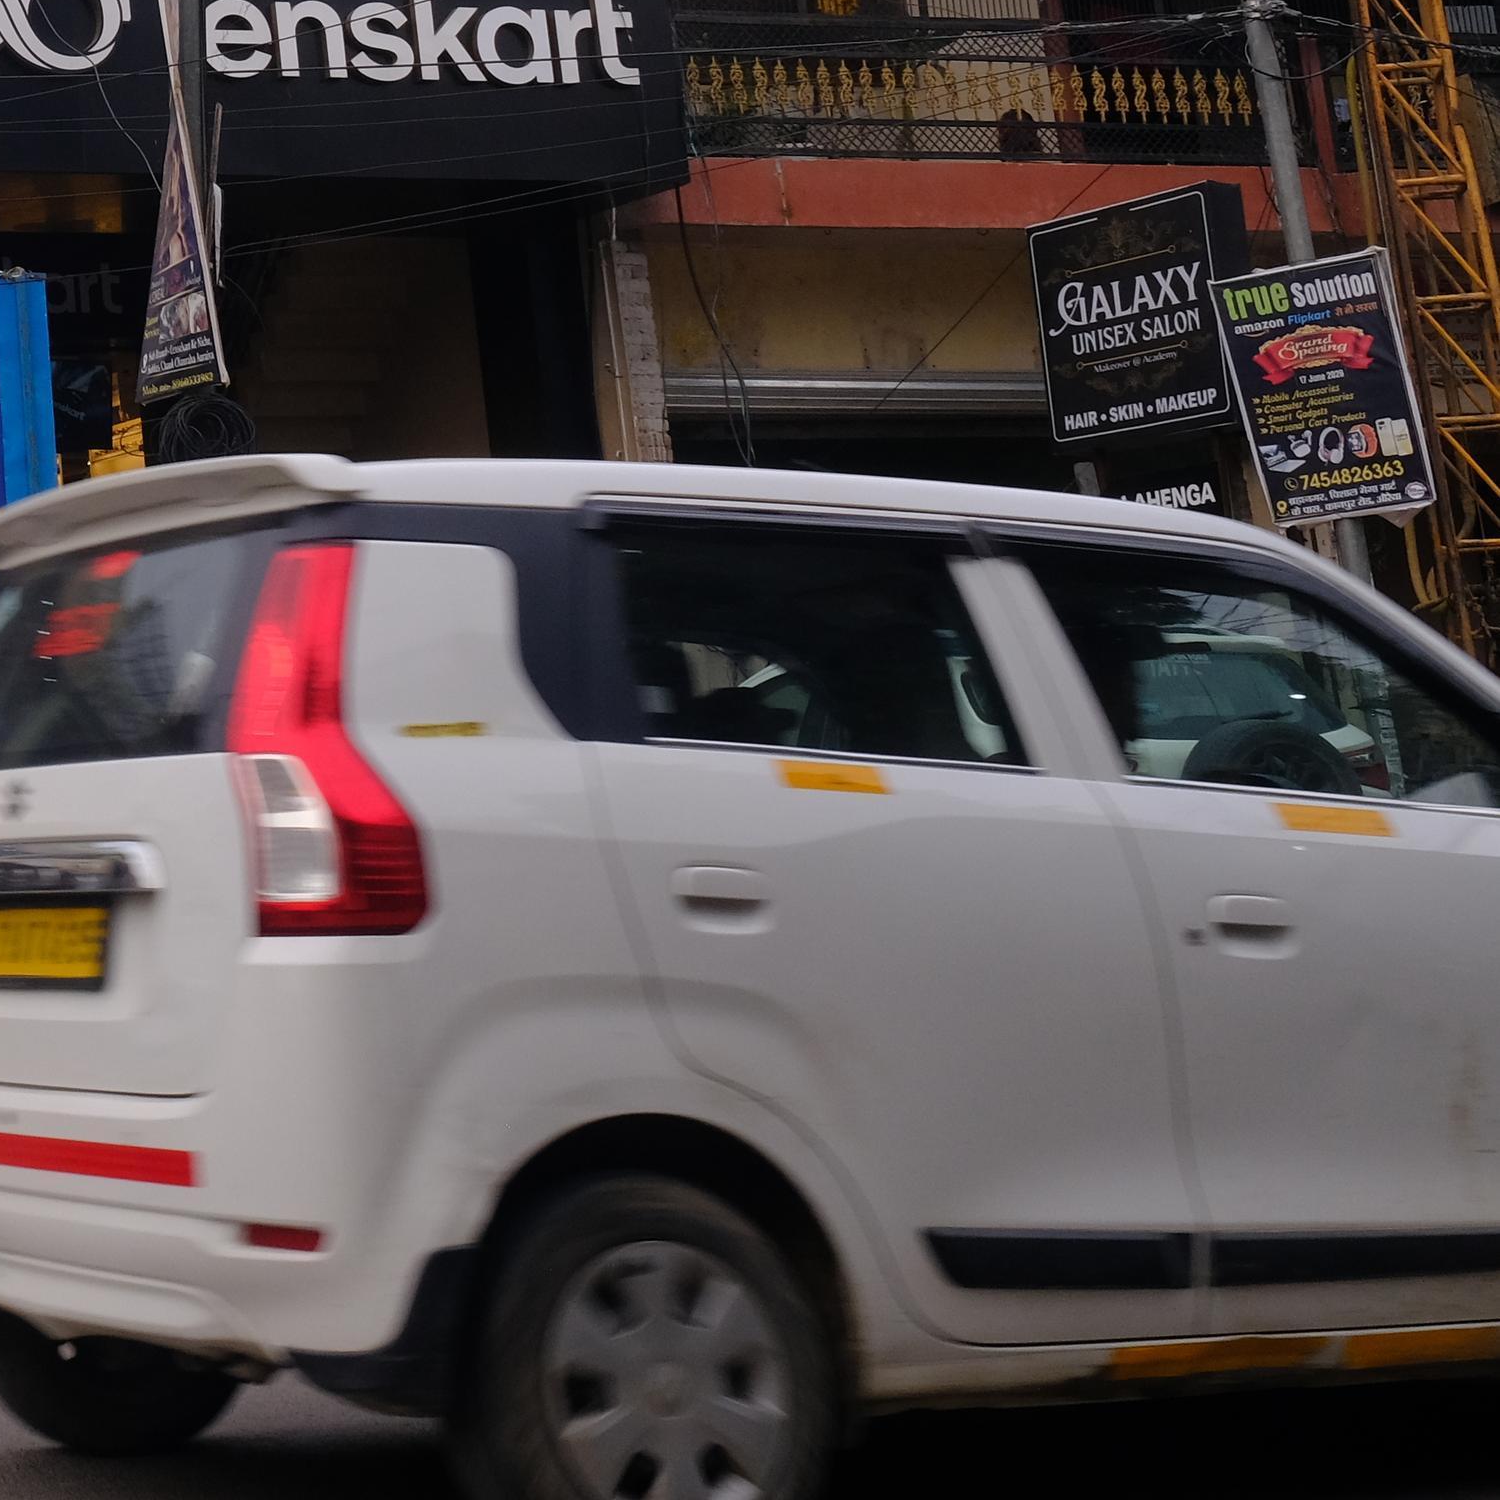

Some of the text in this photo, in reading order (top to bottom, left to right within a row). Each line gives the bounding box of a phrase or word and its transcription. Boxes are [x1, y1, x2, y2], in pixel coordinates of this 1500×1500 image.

[1049, 262, 1200, 337] GALAXY
[1222, 281, 1290, 321] true
[1072, 307, 1201, 355] UNISEX SALON
[1234, 309, 1332, 336] amazon Flipkart
[1278, 341, 1348, 361] Opening
[1283, 334, 1333, 351] Grand
[1064, 388, 1218, 431] HAIR SKIN MAKEUP
[1266, 413, 1293, 425] Smart
[1309, 419, 1329, 430] Care
[1299, 460, 1405, 491] 7454826363
[1121, 481, 1217, 510] AHENGA
